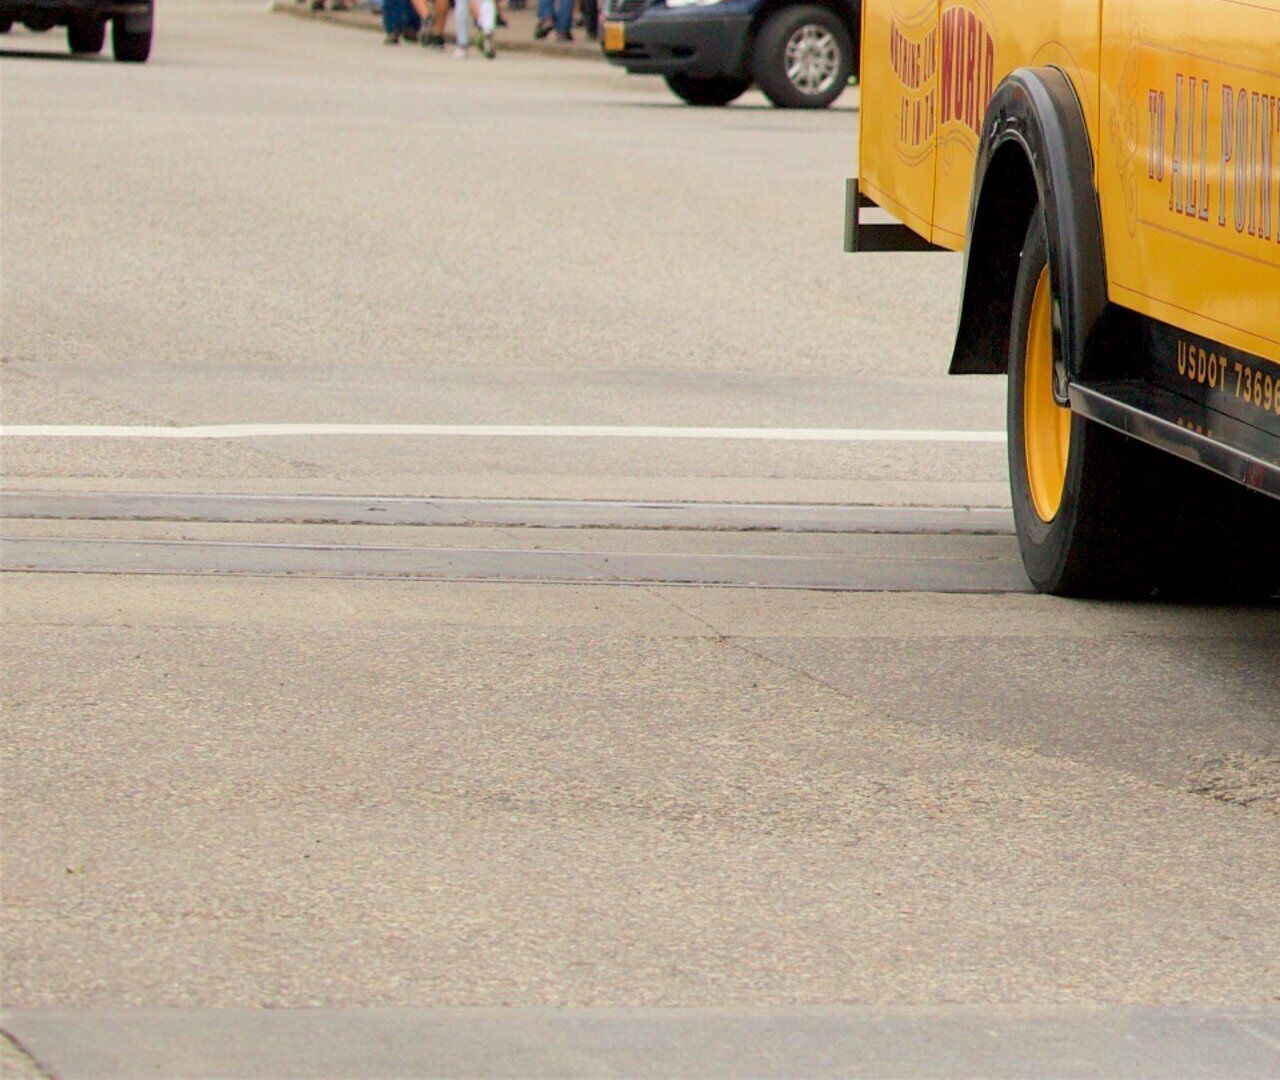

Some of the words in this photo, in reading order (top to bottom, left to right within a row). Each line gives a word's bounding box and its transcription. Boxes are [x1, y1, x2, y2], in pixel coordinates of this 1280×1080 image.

[1149, 88, 1166, 182] TO
[1168, 73, 1210, 222] ALL
[1177, 340, 1228, 392] USDOT
